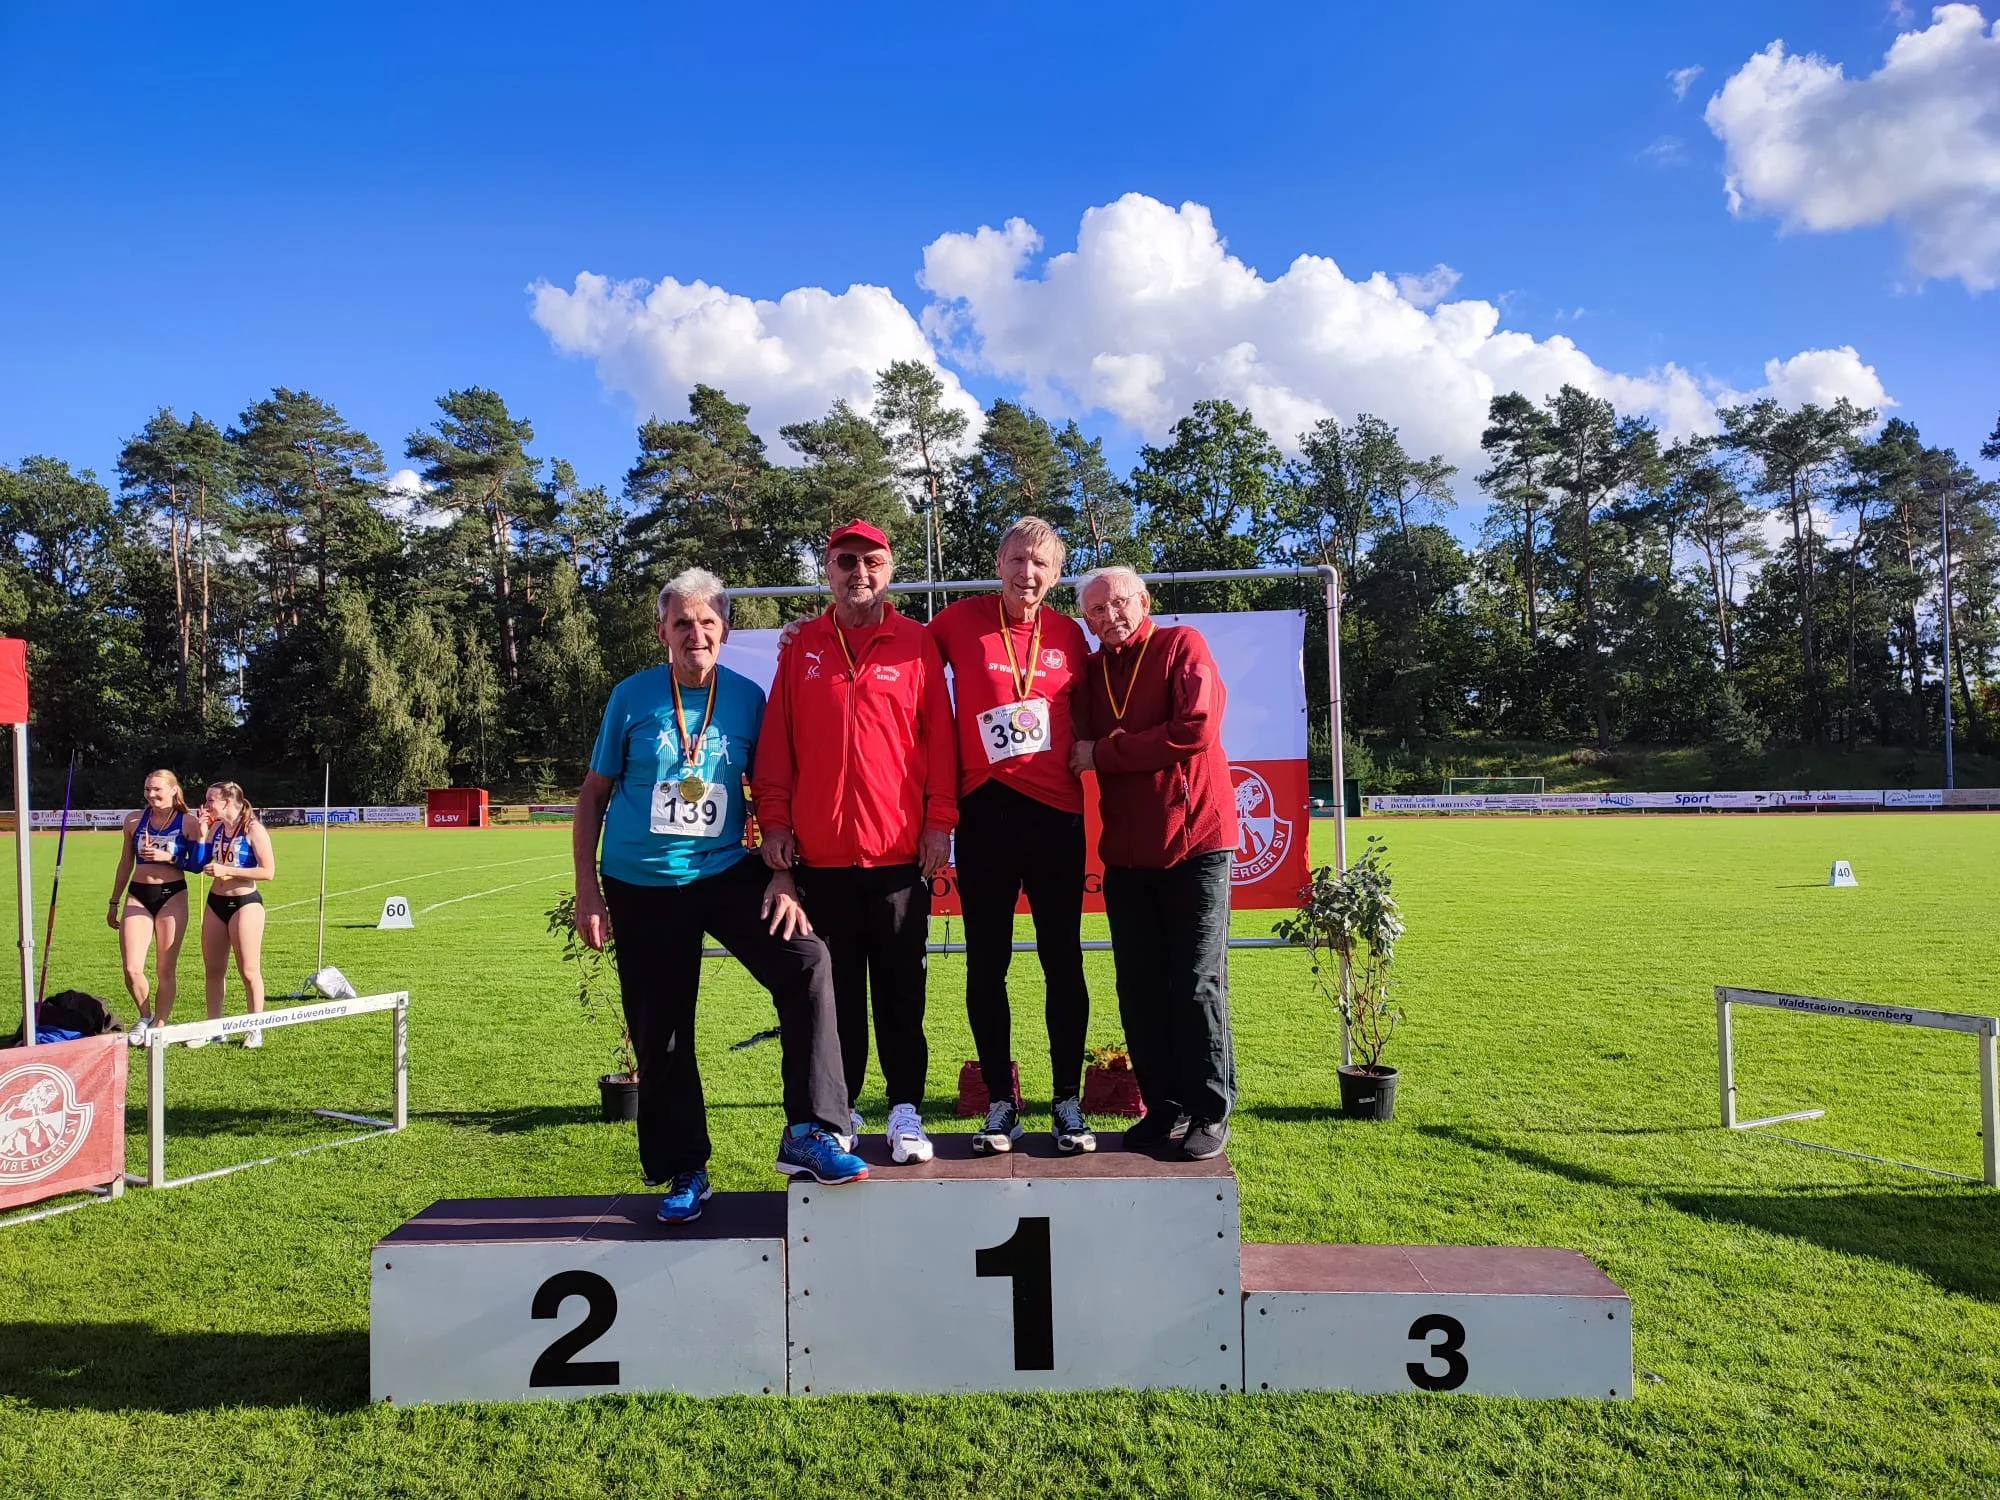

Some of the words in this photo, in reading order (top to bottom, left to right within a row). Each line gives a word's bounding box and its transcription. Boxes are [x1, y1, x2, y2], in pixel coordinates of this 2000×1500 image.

[1675, 794, 1710, 805] Sport
[441, 814, 460, 822] LSV
[664, 797, 717, 826] 139
[1273, 830, 1286, 849] SV
[1837, 867, 1850, 878] 40
[386, 903, 406, 917] 60
[1778, 997, 1845, 1014] Waldstadion
[222, 1015, 288, 1031] Waldstadion
[291, 1005, 347, 1021] Löwenberg
[65, 1118, 78, 1136] SV
[976, 1217, 1054, 1371] 1
[530, 1270, 620, 1388] 2
[1407, 1314, 1469, 1392] 3
